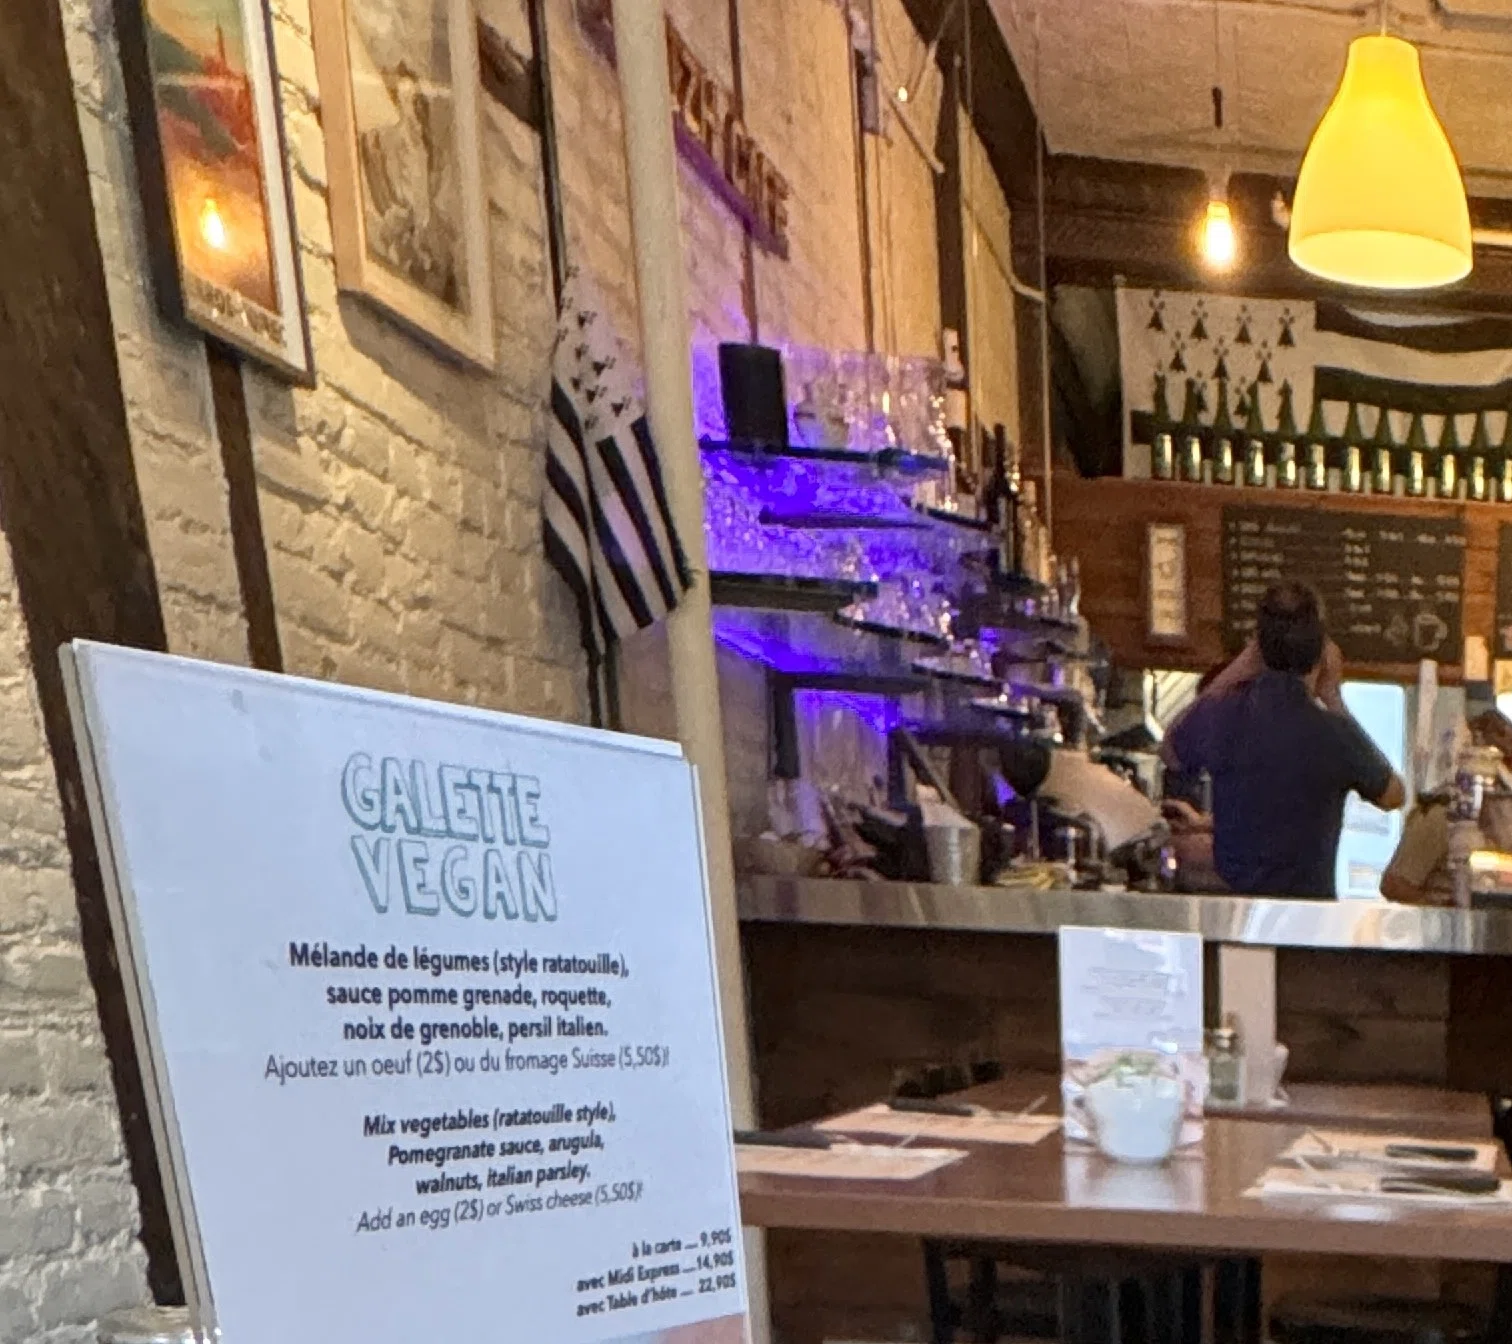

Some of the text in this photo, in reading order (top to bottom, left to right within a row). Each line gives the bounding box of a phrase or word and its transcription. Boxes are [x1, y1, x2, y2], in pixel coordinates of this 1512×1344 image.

[340, 751, 551, 850] GALETTE
[350, 834, 558, 923] VEGAN
[289, 941, 630, 979] Mélande de légumes (style ratatouille),
[326, 983, 612, 1012] sauce pomme grenade, roquette,
[343, 1014, 609, 1046] noix de grenoble, persil italien.
[264, 1054, 338, 1086] Ajoutez
[343, 1059, 366, 1077] un
[371, 1050, 412, 1077] oeuf
[416, 1050, 451, 1079] (2$)
[454, 1055, 476, 1073] ou
[479, 1048, 501, 1073] du
[504, 1047, 569, 1076] fromage
[572, 1046, 616, 1070] Suisse
[363, 1113, 396, 1137] Mix
[400, 1107, 489, 1138] vegetables
[493, 1103, 573, 1131] (ratatouille
[388, 1128, 605, 1168] Pomegranate sauce, arugula,
[416, 1171, 483, 1195] walnuts,
[536, 1158, 591, 1189] parsley.
[356, 1205, 393, 1234] Add
[395, 1211, 416, 1228] an
[420, 1208, 451, 1230] egg
[454, 1198, 485, 1224] (2$)
[486, 1201, 502, 1217] or
[504, 1192, 543, 1216] Swiss
[546, 1188, 593, 1210] cheese
[655, 1238, 682, 1254] carte
[576, 1276, 604, 1292] avec
[608, 1266, 634, 1286] Midi
[637, 1264, 680, 1283] Express
[576, 1300, 604, 1317] avec
[607, 1291, 638, 1311] Table
